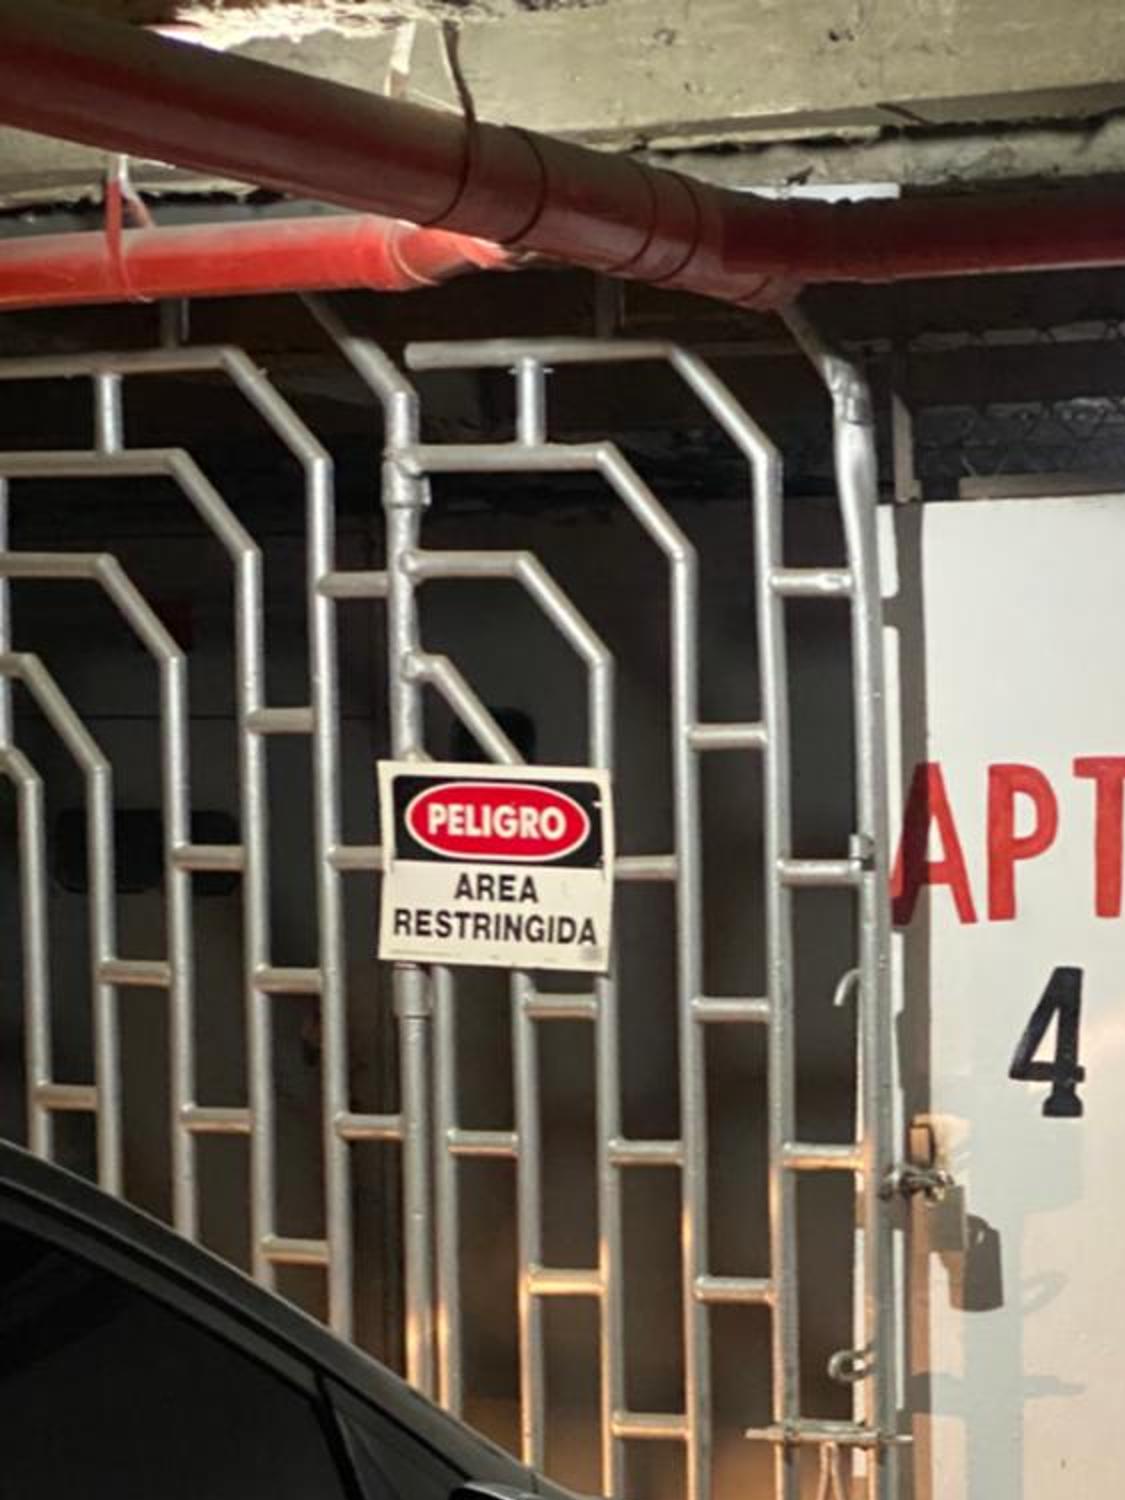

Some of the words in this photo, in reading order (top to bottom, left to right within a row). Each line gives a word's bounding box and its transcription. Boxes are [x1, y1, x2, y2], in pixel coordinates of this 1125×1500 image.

[427, 802, 567, 840] PELIGRO
[454, 873, 539, 903] AREA
[393, 908, 597, 945] RESTRINGIDA
[1009, 966, 1085, 1118] 4
